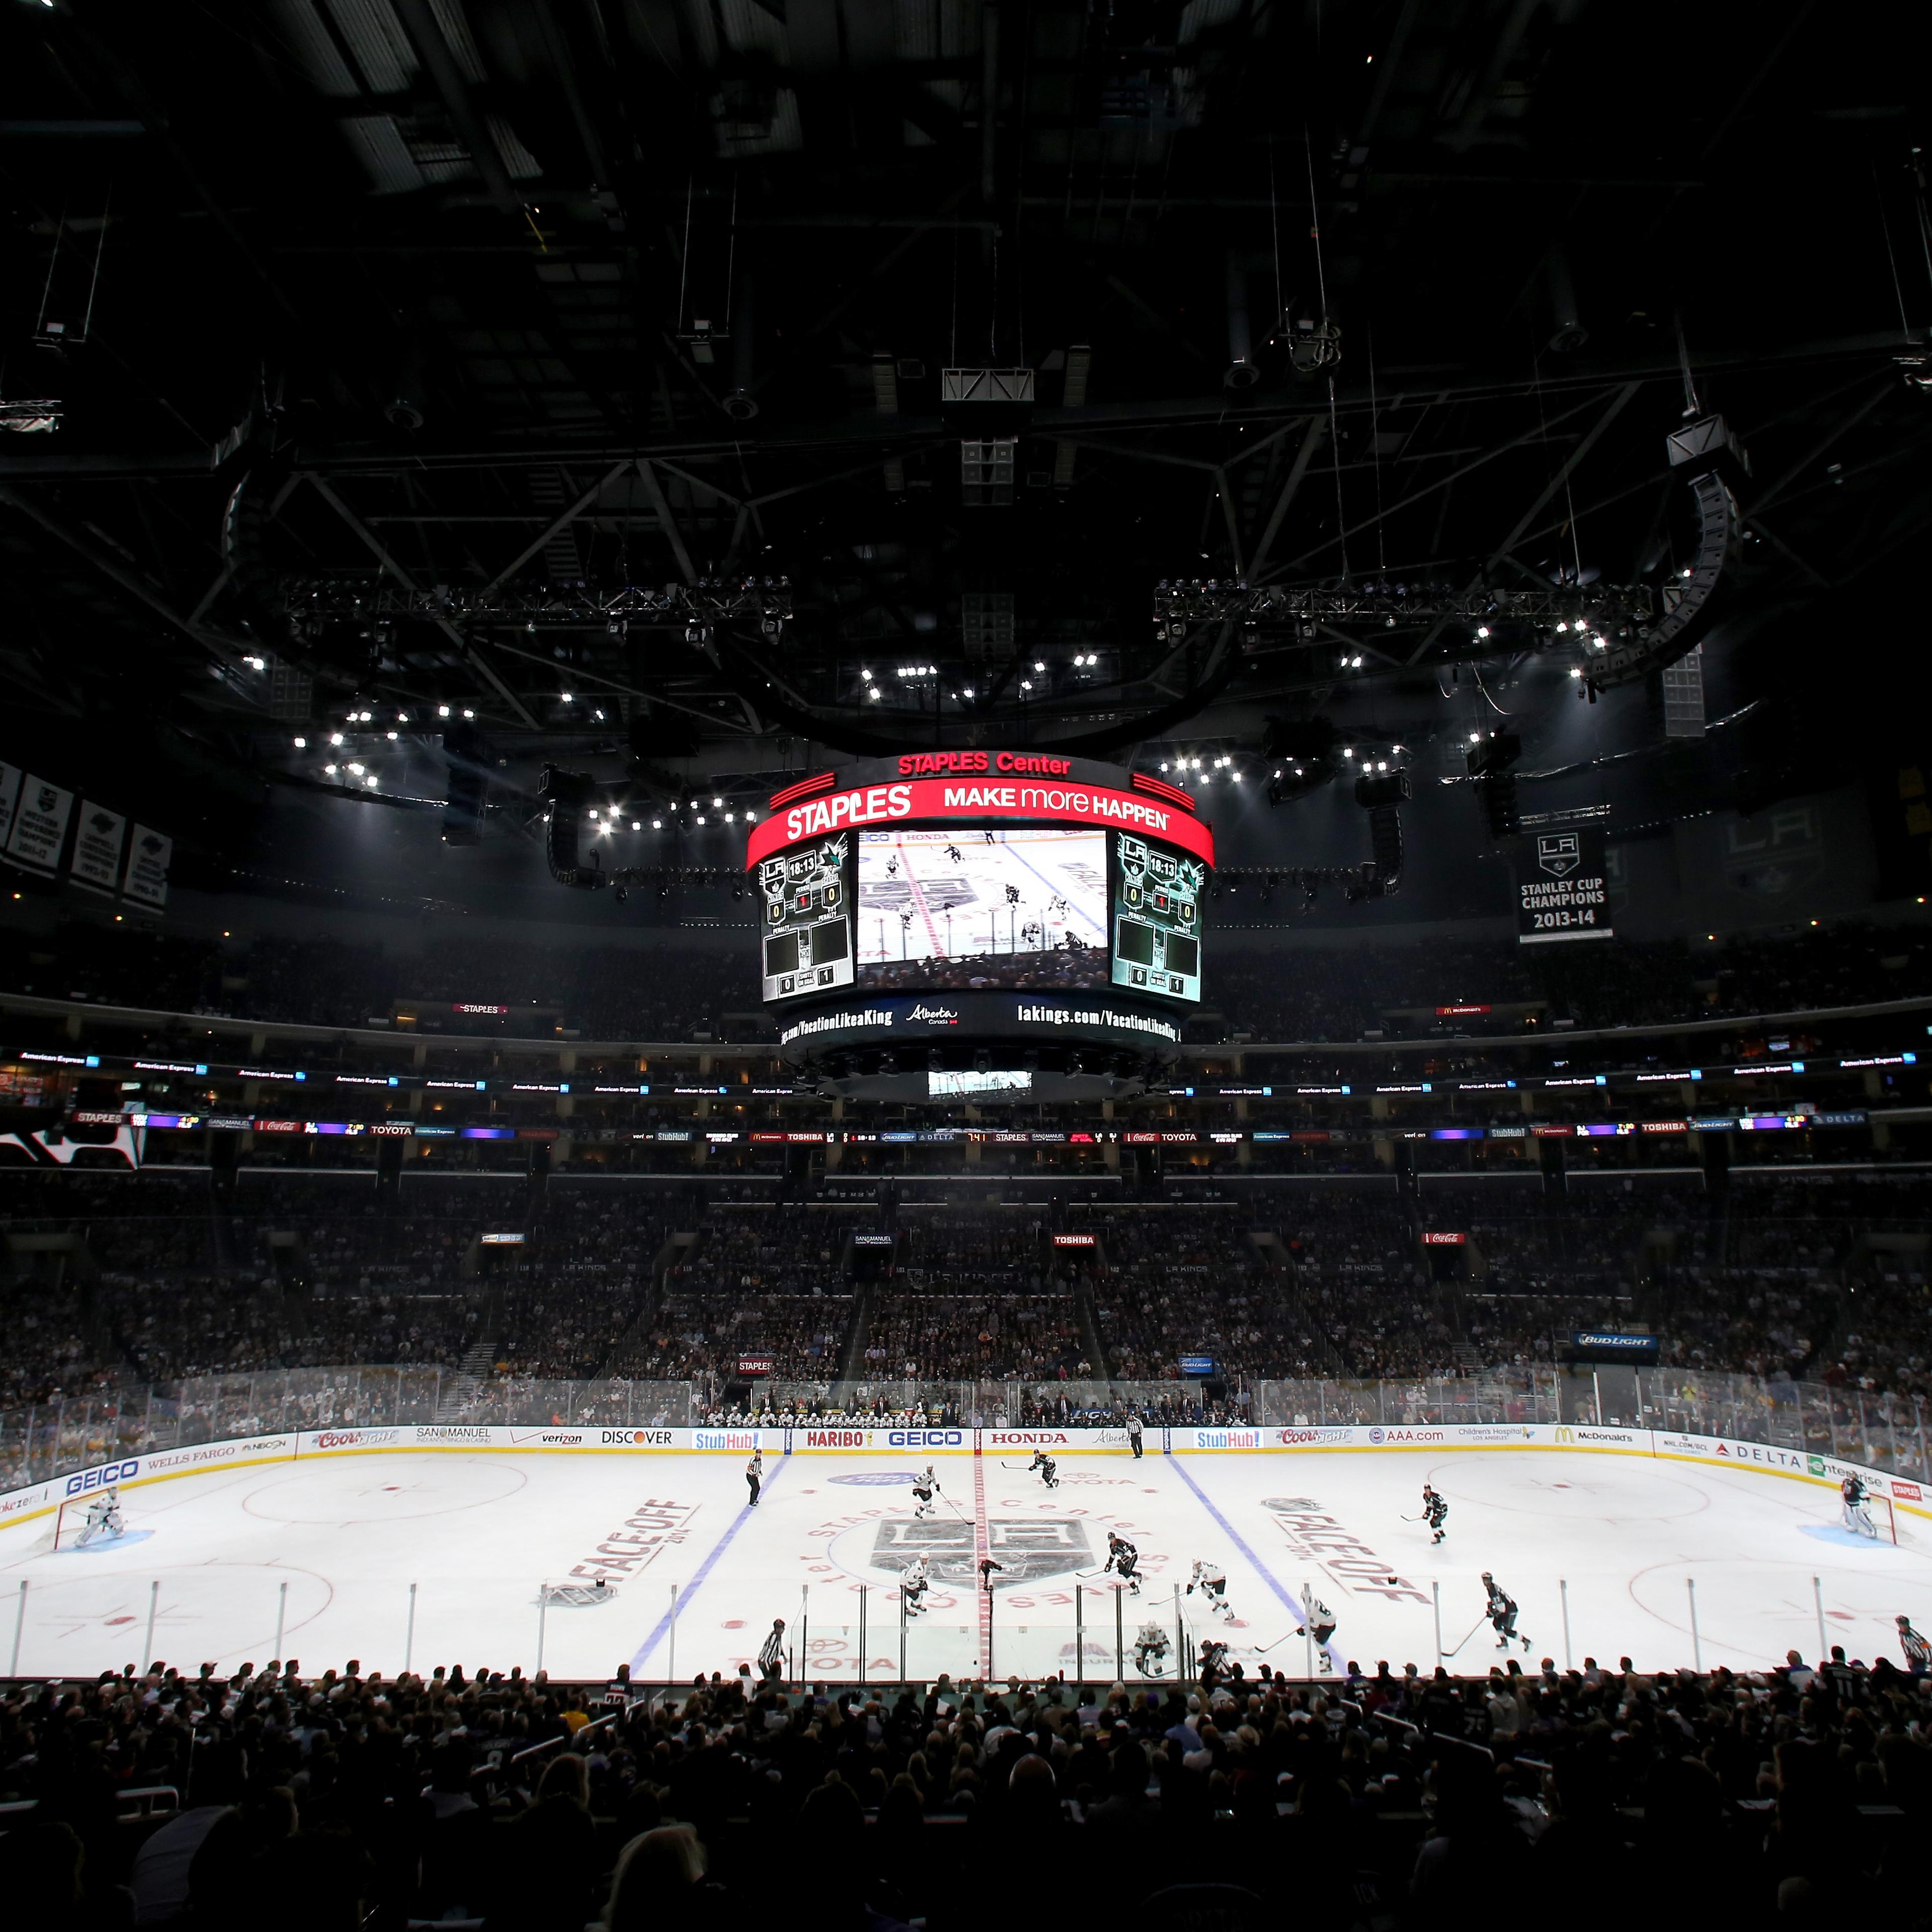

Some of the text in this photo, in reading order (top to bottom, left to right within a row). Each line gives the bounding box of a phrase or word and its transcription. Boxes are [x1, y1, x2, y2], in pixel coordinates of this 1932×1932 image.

[898, 752, 1071, 775] STAPLES Center
[787, 785, 911, 840] STAPLES
[945, 788, 1167, 831] MAKE more HAPPEN
[1125, 841, 1145, 861] LA
[1541, 838, 1575, 853] LA
[765, 863, 785, 879] LA
[790, 857, 815, 877] 18:13
[1151, 857, 1174, 877] 18:13
[1125, 873, 1143, 884] KINGS
[1521, 877, 1603, 896] STANLEY CUP
[767, 891, 785, 903] KINGS
[829, 888, 835, 901] 0
[1131, 889, 1137, 901] 0
[1521, 891, 1605, 910] CHAMPIONS
[800, 896, 806, 906] 1
[1159, 897, 1164, 907] 1
[773, 905, 780, 918] 0
[818, 911, 837, 922] PENALTY
[1128, 911, 1147, 922] PENALTY
[1184, 905, 1191, 918] 0
[1534, 909, 1595, 928] 2013-14
[773, 925, 790, 935] PENALTY
[1174, 924, 1191, 935] PENALTY
[824, 970, 829, 982] 1
[1137, 971, 1143, 982] 0
[784, 979, 790, 990] 0
[1174, 979, 1179, 991] 1
[464, 1004, 499, 1014] STAPLES
[906, 1004, 958, 1020] Alberta
[1017, 1005, 1176, 1042] lakings.com/VacationLikeaKing
[20, 1052, 85, 1065] American Express
[1840, 1056, 1902, 1067] American Express
[134, 1062, 195, 1073] American Express
[1765, 1065, 1792, 1073] Express
[238, 1069, 294, 1080] American Express
[335, 1075, 387, 1085] American Express
[1666, 1072, 1690, 1080] Express
[1572, 1077, 1595, 1085] Express
[78, 1113, 121, 1123] STAPLES
[1826, 1114, 1865, 1123] DELTA
[371, 1126, 412, 1135] TOYOTA
[1492, 1129, 1525, 1138] StubHub!
[658, 1133, 689, 1141] StubHub!
[1432, 1234, 1458, 1243] Coca-Cola
[739, 1362, 772, 1371] STAPLES
[417, 1428, 491, 1437] SAN MANUEL
[602, 1430, 672, 1444] DISCOVER
[1282, 1429, 1318, 1444] Coors
[1387, 1430, 1444, 1441] AAA.com
[1459, 1427, 1522, 1436] Children's Hospital
[1578, 1431, 1633, 1443] McDonald's
[317, 1432, 360, 1448] Coors
[542, 1433, 582, 1443] verizon
[696, 1431, 759, 1450] StubHub!
[807, 1431, 863, 1447] HARIBO
[889, 1431, 962, 1446] GEICO
[991, 1433, 1068, 1443] HONDA
[1197, 1430, 1259, 1448] StubHub!
[148, 1447, 235, 1470] WELLS FARGO
[1737, 1445, 1801, 1468] DELTA
[66, 1461, 139, 1495] GEICO
[1893, 1484, 1920, 1498] STAPLES
[0, 1501, 16, 1514] oke
[664, 1527, 693, 1545] 2014
[728, 1658, 898, 1670] TYOTA
